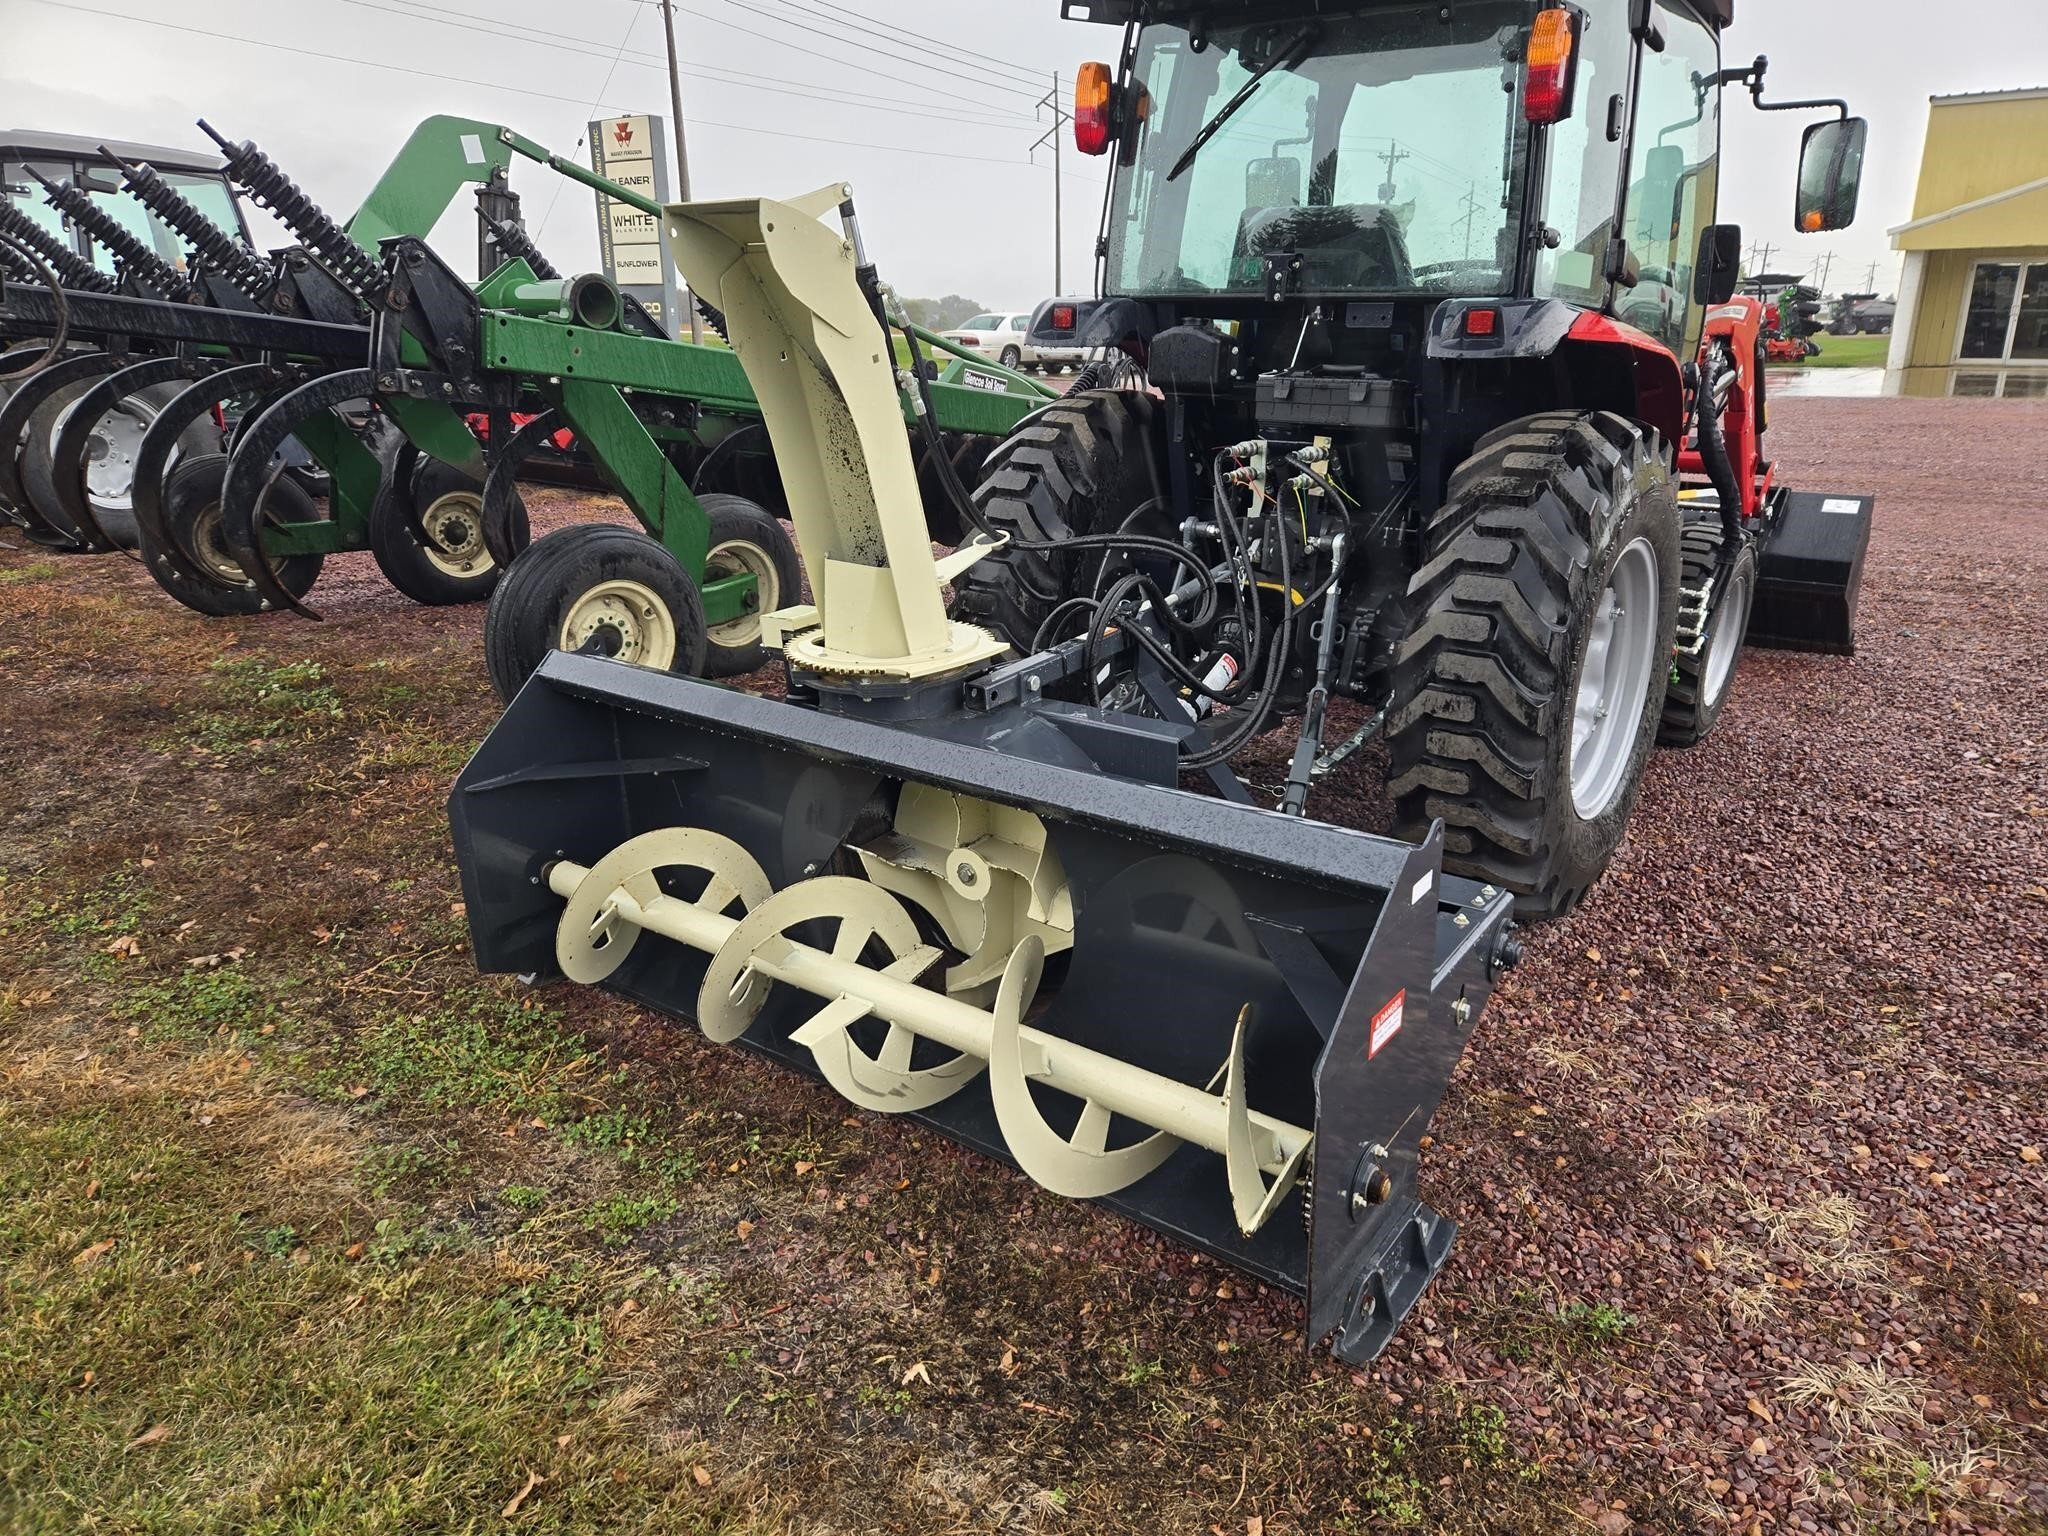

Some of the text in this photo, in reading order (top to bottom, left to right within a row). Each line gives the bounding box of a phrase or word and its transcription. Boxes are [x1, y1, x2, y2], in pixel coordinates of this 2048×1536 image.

[600, 204, 608, 230] FARM
[613, 214, 654, 227] WHITE
[602, 232, 612, 268] MIDWAY
[616, 260, 658, 268] SUNFLOWER
[965, 371, 985, 388] Glencoe
[985, 377, 994, 390] Soil
[1380, 996, 1402, 1025] DANGER
